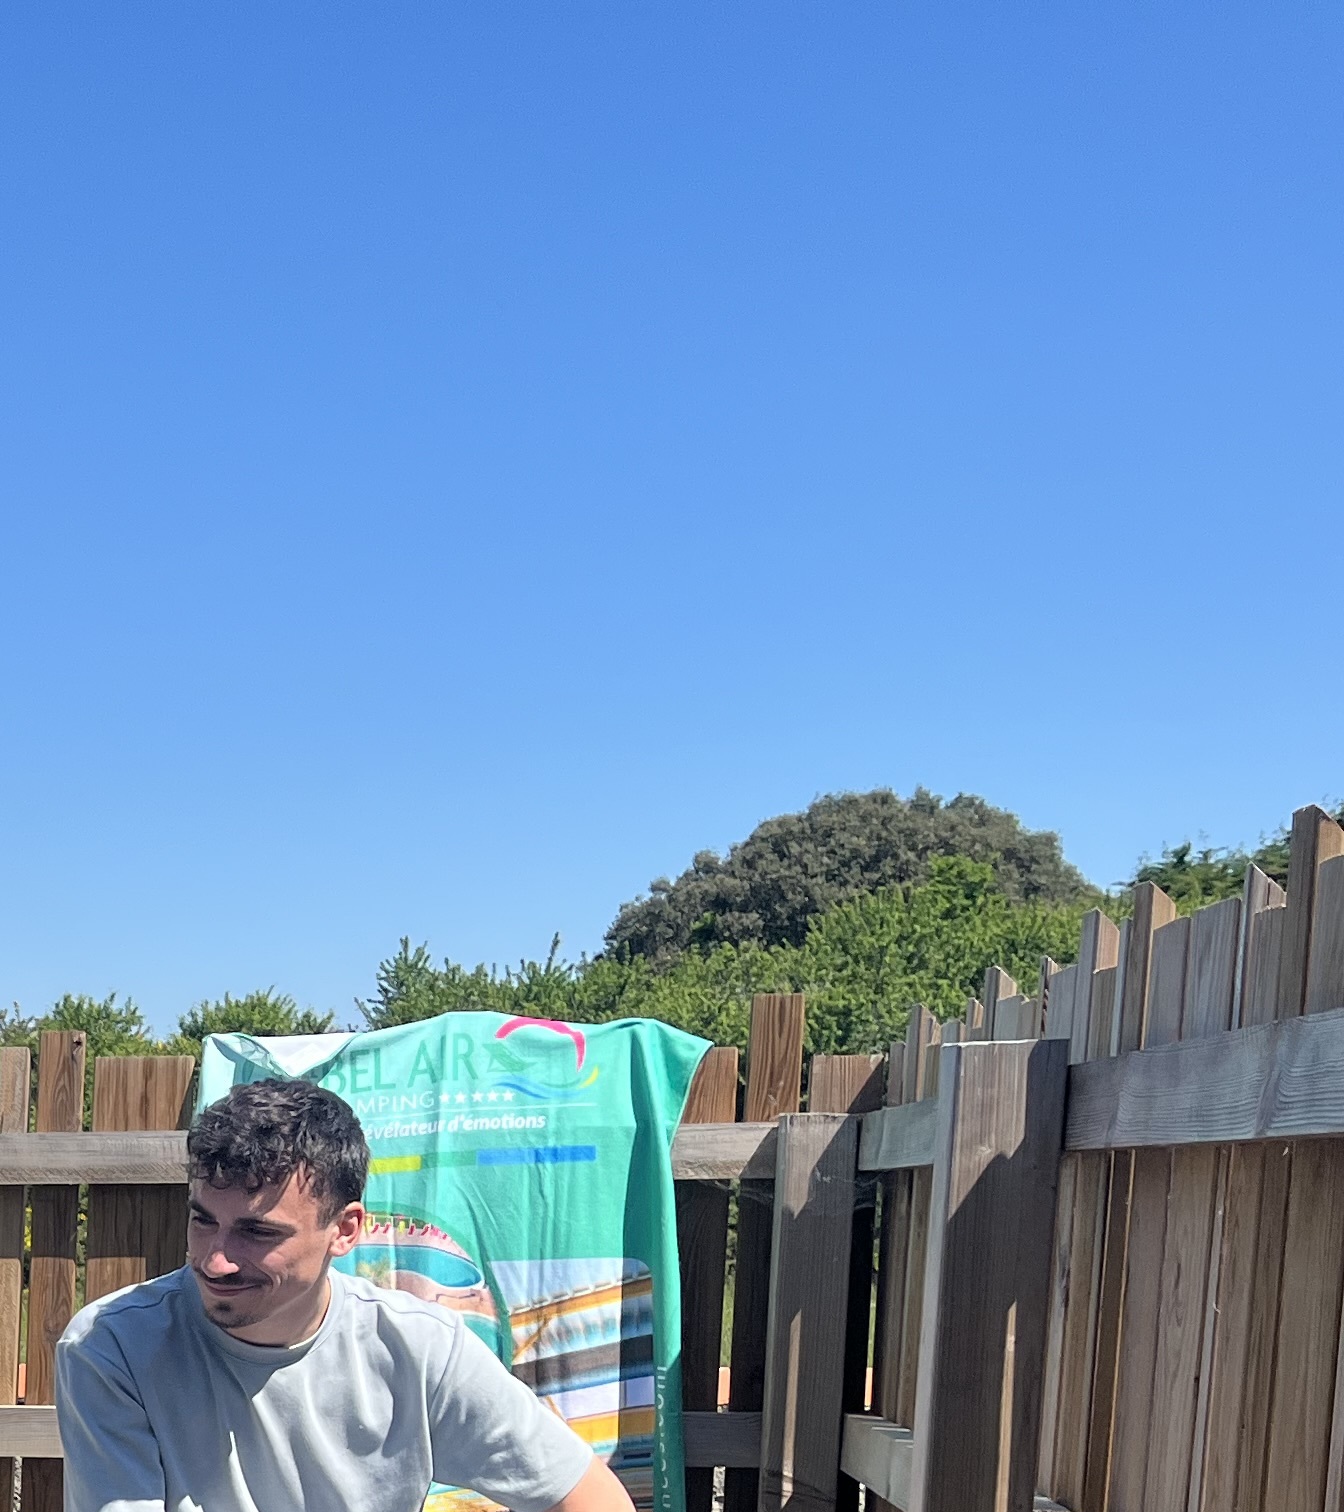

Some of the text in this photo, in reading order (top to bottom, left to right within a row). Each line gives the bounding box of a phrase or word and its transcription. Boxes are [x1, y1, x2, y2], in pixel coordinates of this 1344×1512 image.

[322, 1048, 397, 1095] BEL
[407, 1032, 479, 1088] AIR
[355, 1091, 435, 1115] MPING
[363, 1114, 547, 1140] évélateur d'émotions
